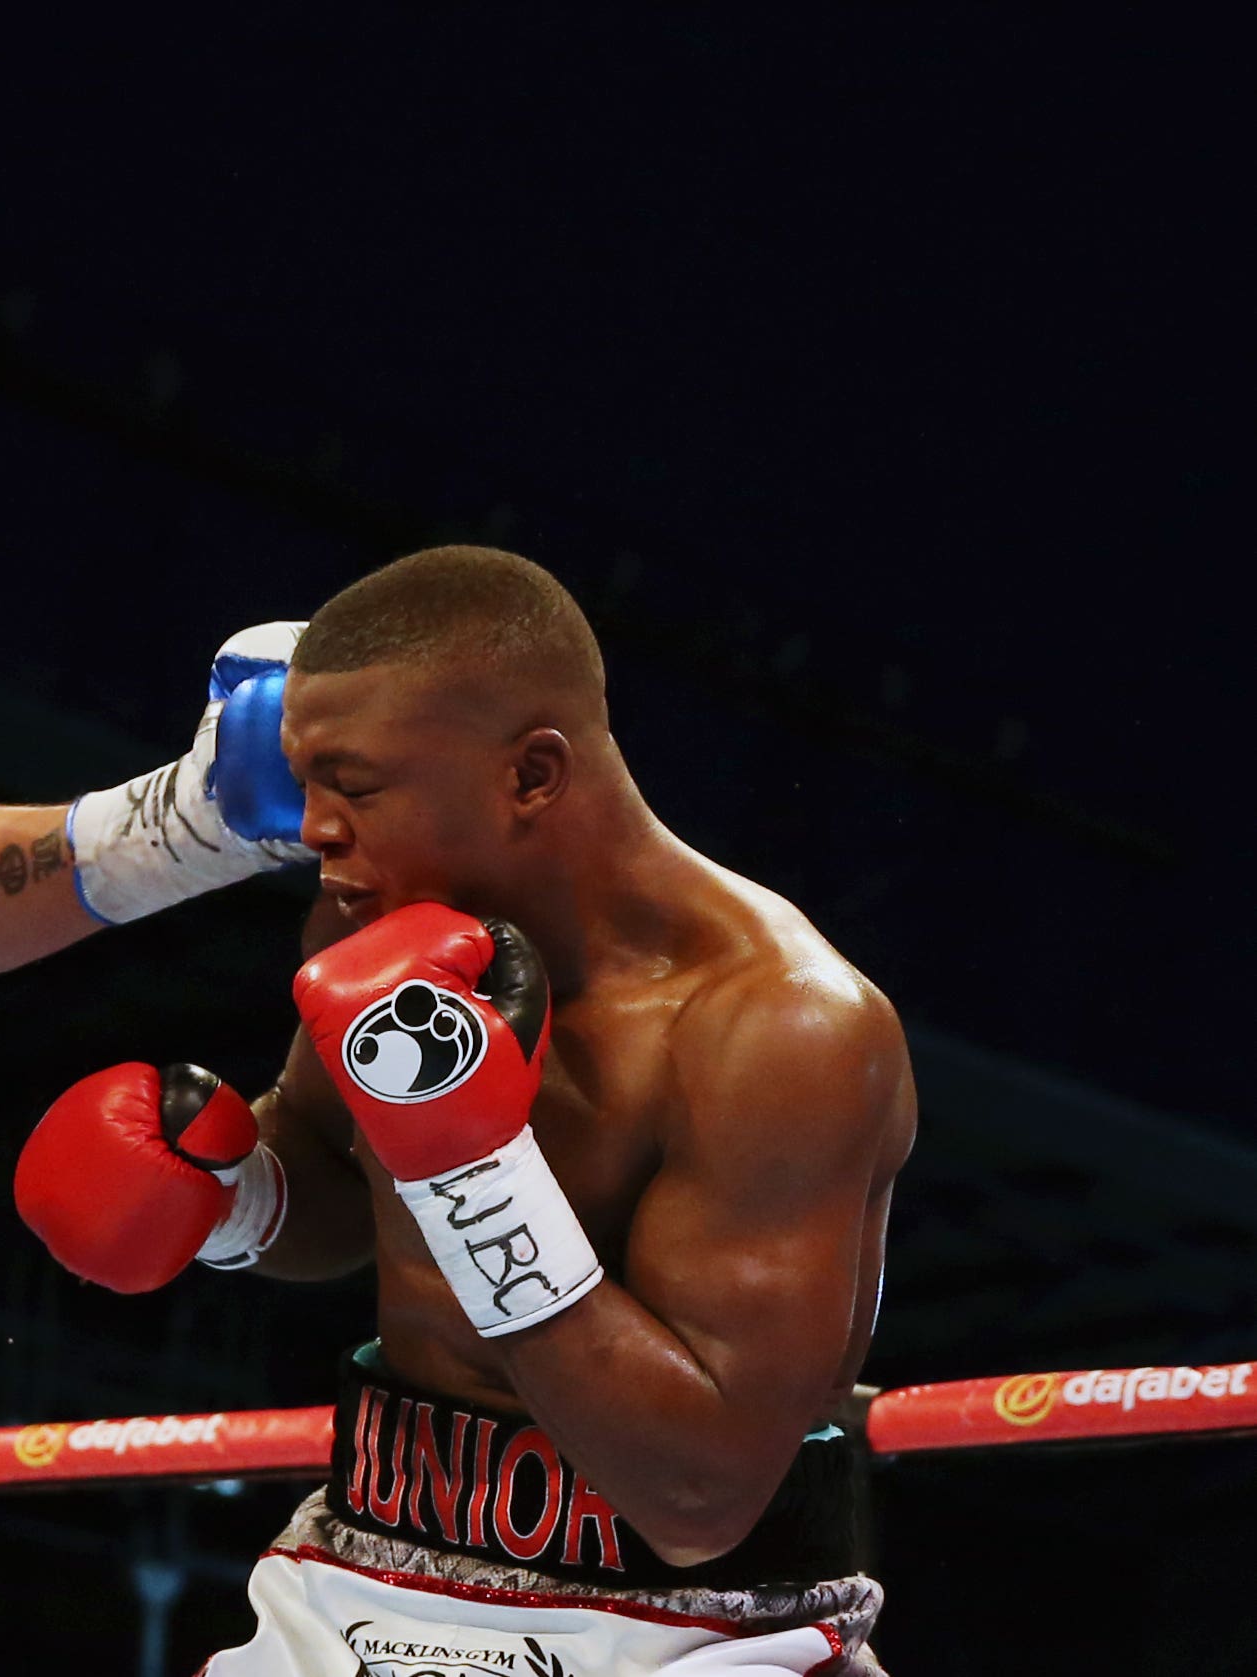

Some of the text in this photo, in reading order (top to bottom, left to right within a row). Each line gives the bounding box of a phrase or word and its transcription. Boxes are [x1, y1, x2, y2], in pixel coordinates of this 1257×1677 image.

[429, 1159, 560, 1316] WBC
[68, 1413, 224, 1456] dafabet
[1062, 1363, 1253, 1412] dafabet
[348, 1385, 625, 1572] JUNIOR
